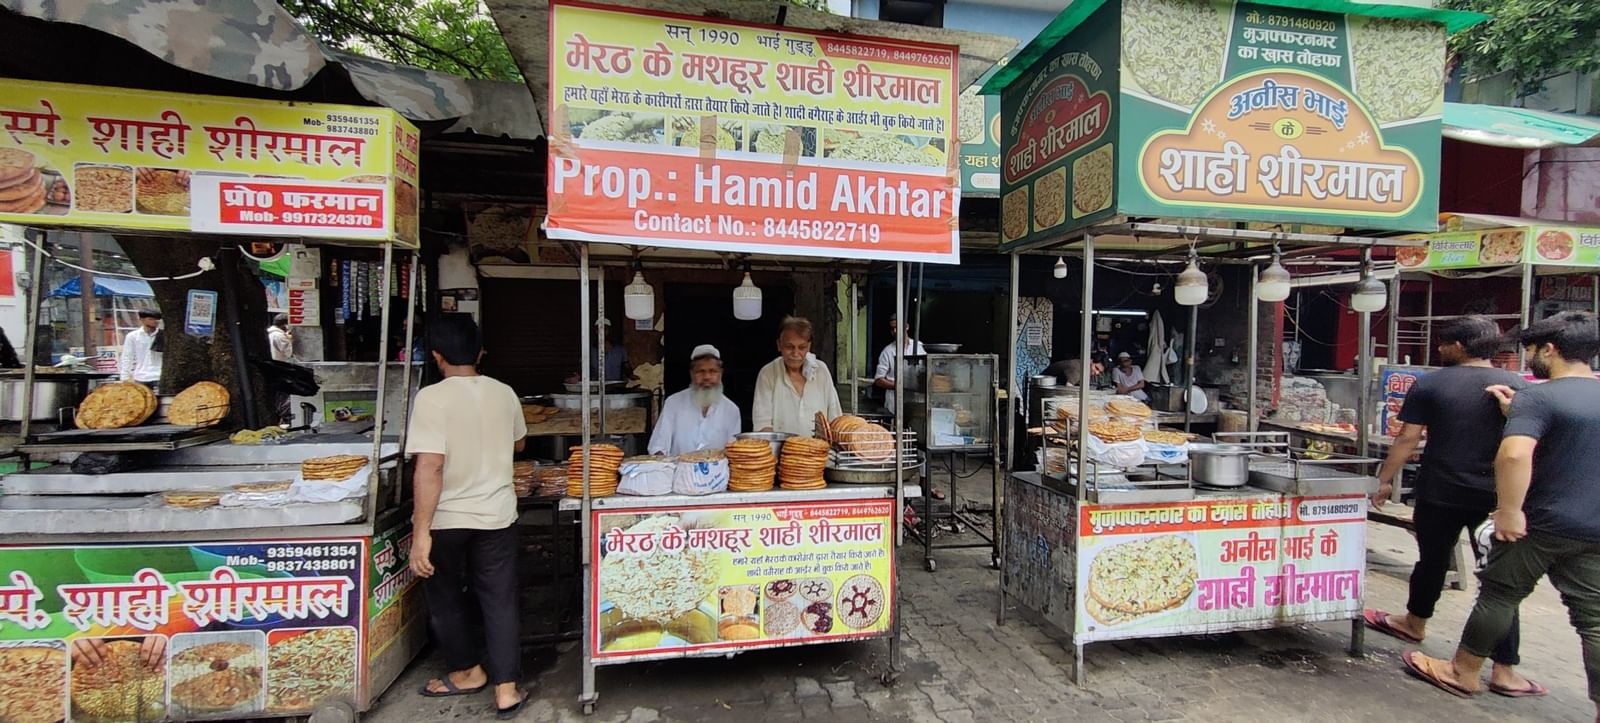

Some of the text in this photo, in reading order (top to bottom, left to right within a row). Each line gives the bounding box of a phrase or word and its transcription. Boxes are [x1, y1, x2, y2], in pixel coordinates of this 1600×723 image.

[1267, 13, 1336, 33] 8791480920
[664, 24, 696, 46] सन्
[699, 27, 740, 46] 1990
[756, 33, 781, 50] भाई
[826, 41, 951, 67] 8445822719, 8449762620
[1237, 44, 1258, 60] का
[1296, 46, 1342, 69] तोहफा
[566, 33, 942, 105] मेरठ के मशहूर शाही शीरमाल
[564, 84, 587, 101] हमारे
[611, 88, 630, 104] मेरठ
[633, 90, 642, 105] के
[644, 92, 682, 110] कारीगरों
[705, 96, 728, 113] तैयार
[730, 99, 749, 115] किये
[751, 102, 771, 117] जाते
[784, 104, 805, 121] शादी
[836, 108, 845, 124] के
[870, 112, 880, 127] भी
[882, 115, 896, 132] बुक
[898, 114, 915, 130] किये
[917, 116, 934, 131] जाते
[1227, 78, 1350, 130] अनीस भाई
[303, 114, 380, 128] Mob- 9359461354
[326, 124, 379, 137] 9837438801
[1281, 122, 1294, 137] के
[87, 111, 191, 158] शाही
[203, 116, 366, 167] शीरमाल
[1010, 102, 1103, 177] शाही शीरमाल
[1159, 144, 1407, 203] शाही शीरमाल
[281, 190, 381, 212] फरमान
[553, 157, 947, 219] Prop.: Hamid Akhtar
[239, 211, 373, 227] Mob- 9917324370
[633, 210, 880, 244] Contact No.: 8445822719
[751, 513, 772, 522] 1990
[851, 505, 890, 516] 8449762620
[1186, 503, 1207, 522] का
[1312, 503, 1359, 517] 8791480920
[607, 518, 883, 554] मेरठ के मशहूर शाही शीरमाल
[1219, 528, 1338, 563] अनीस भाई के
[226, 545, 357, 567] Mob- 9359461354
[267, 559, 356, 572] 9837438801
[62, 568, 171, 631] शाही
[178, 568, 354, 628] शीरमाल
[1196, 563, 1360, 612] शाही शीरमाल
